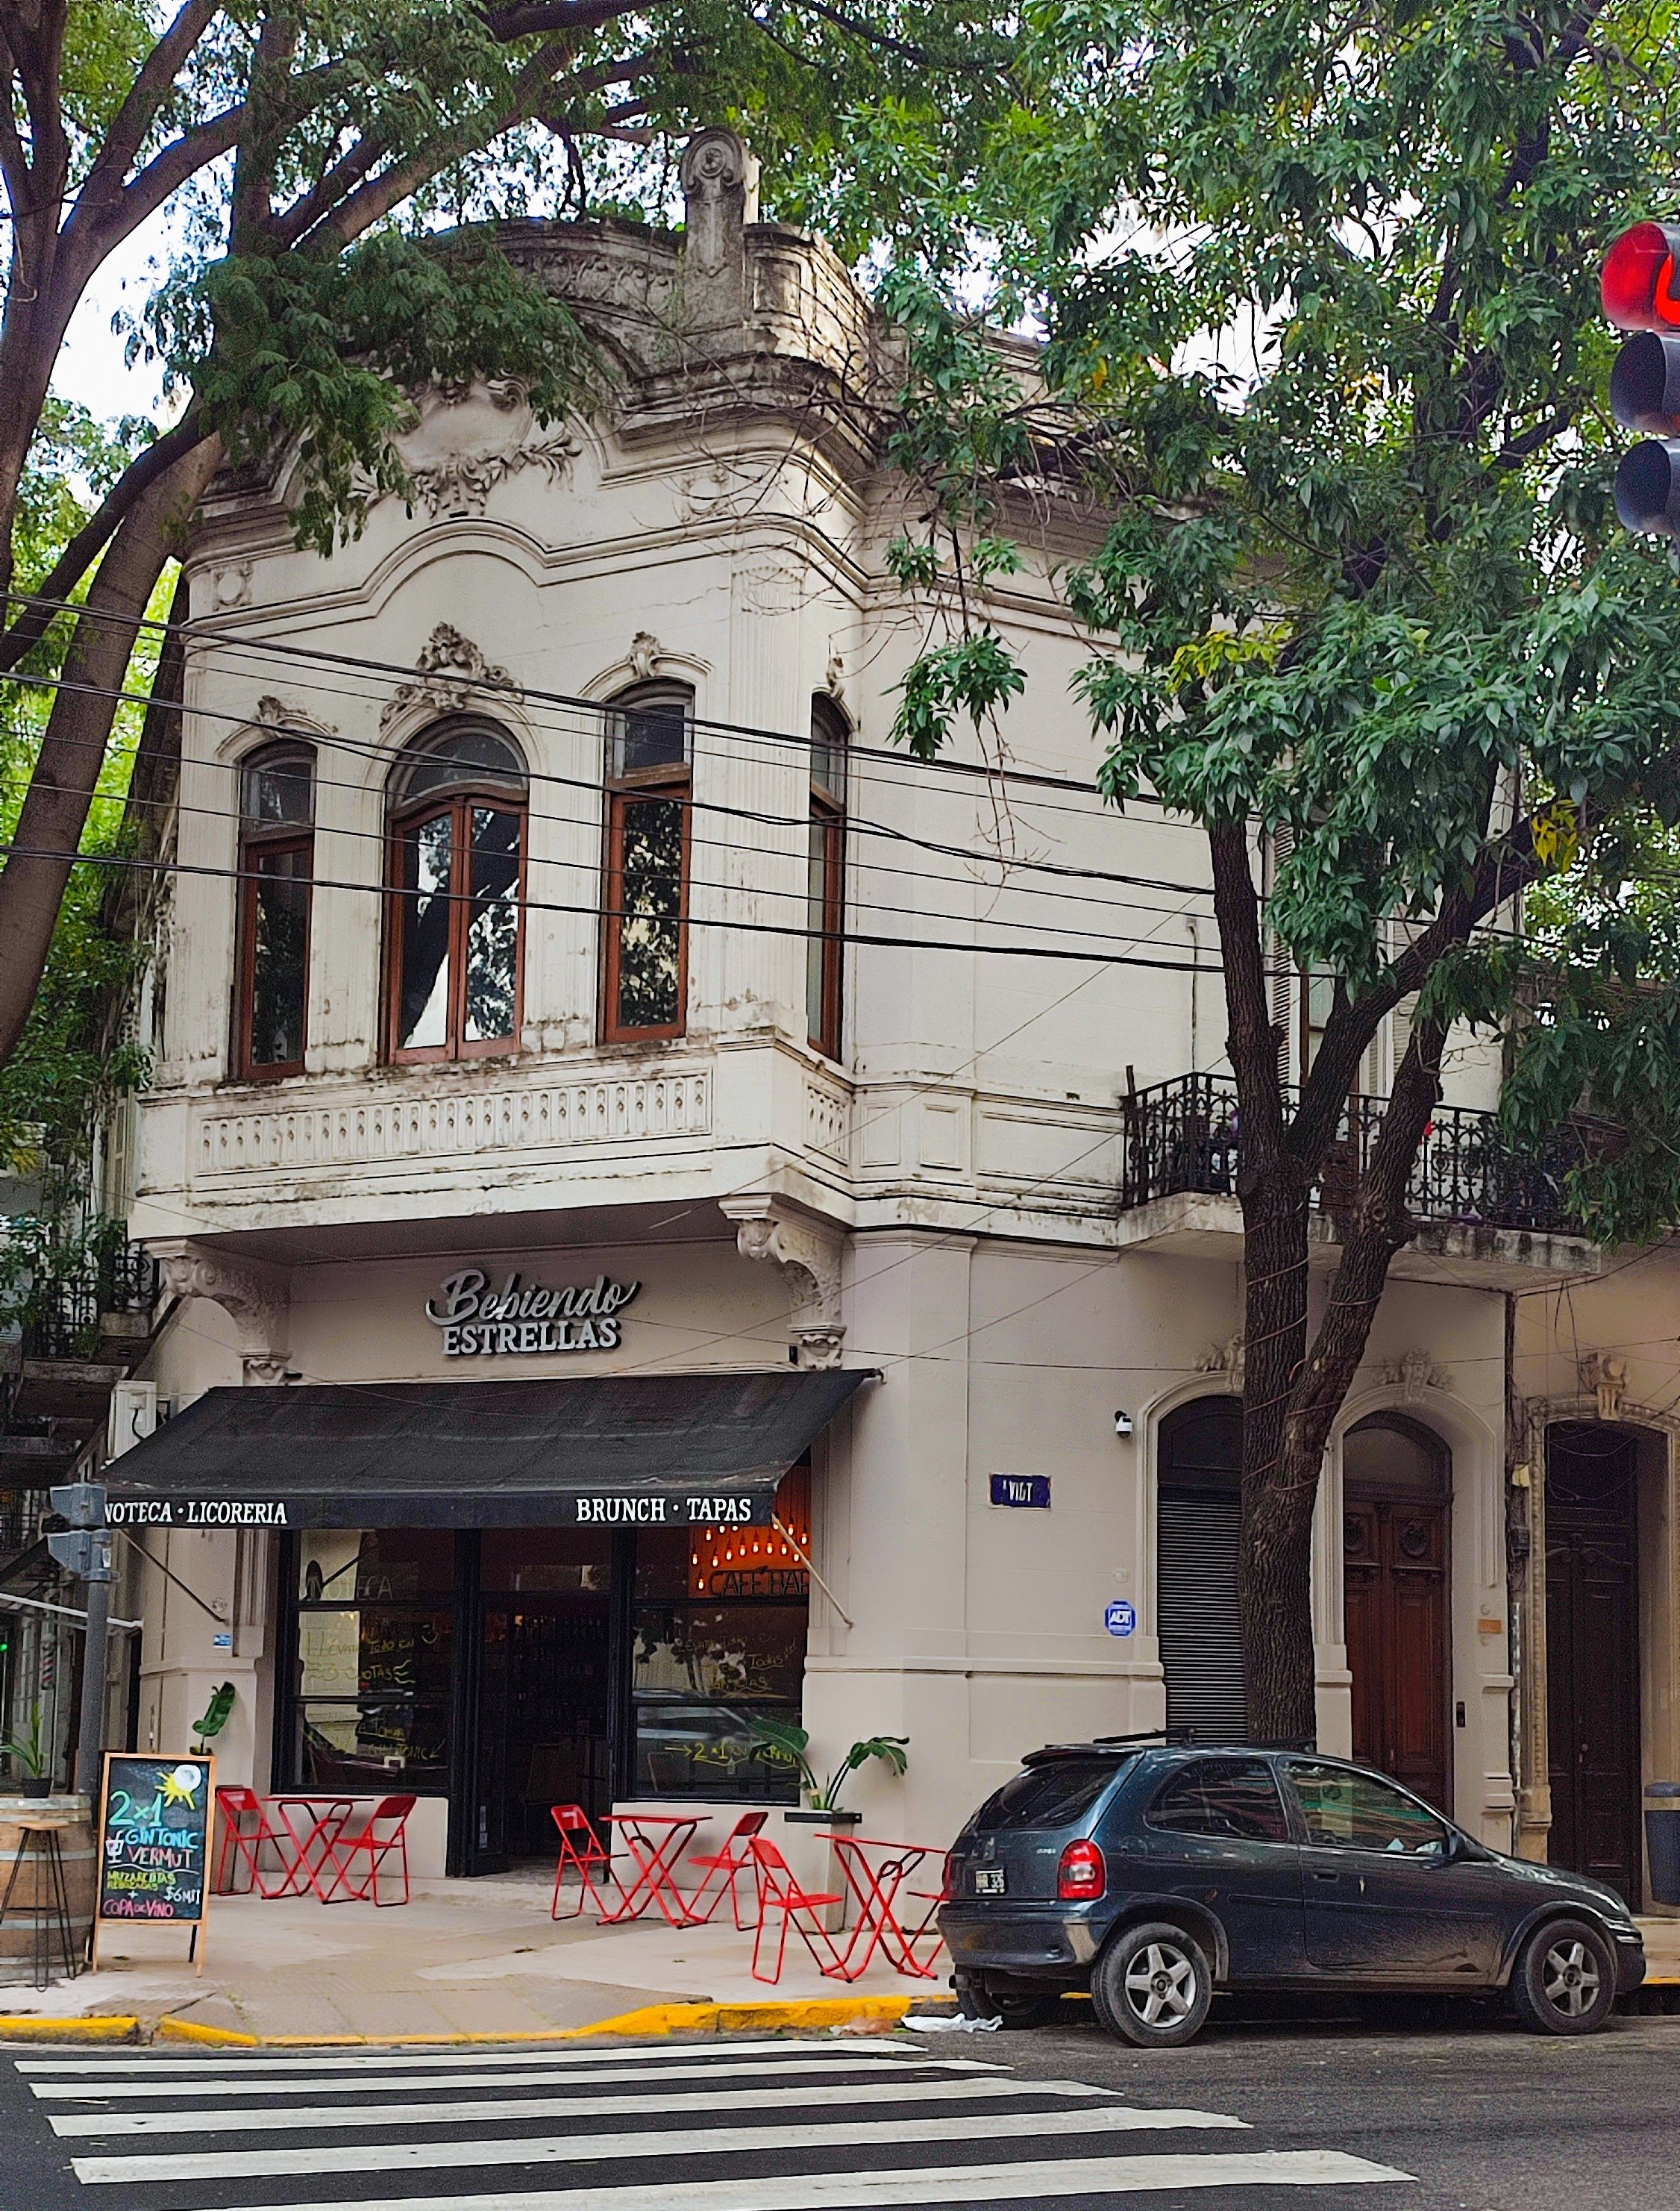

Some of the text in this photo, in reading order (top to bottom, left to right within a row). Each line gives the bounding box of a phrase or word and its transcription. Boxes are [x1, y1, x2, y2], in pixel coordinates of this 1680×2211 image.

[425, 1269, 641, 1326] Bebiendo
[442, 1318, 621, 1357] ESTRELLAS
[186, 1501, 287, 1524] LICORERIA
[576, 1498, 751, 1522] BRUNCH TAPAS
[109, 1790, 162, 1827] 2x1
[103, 1898, 134, 1917] COPA
[145, 1899, 175, 1918] VINO
